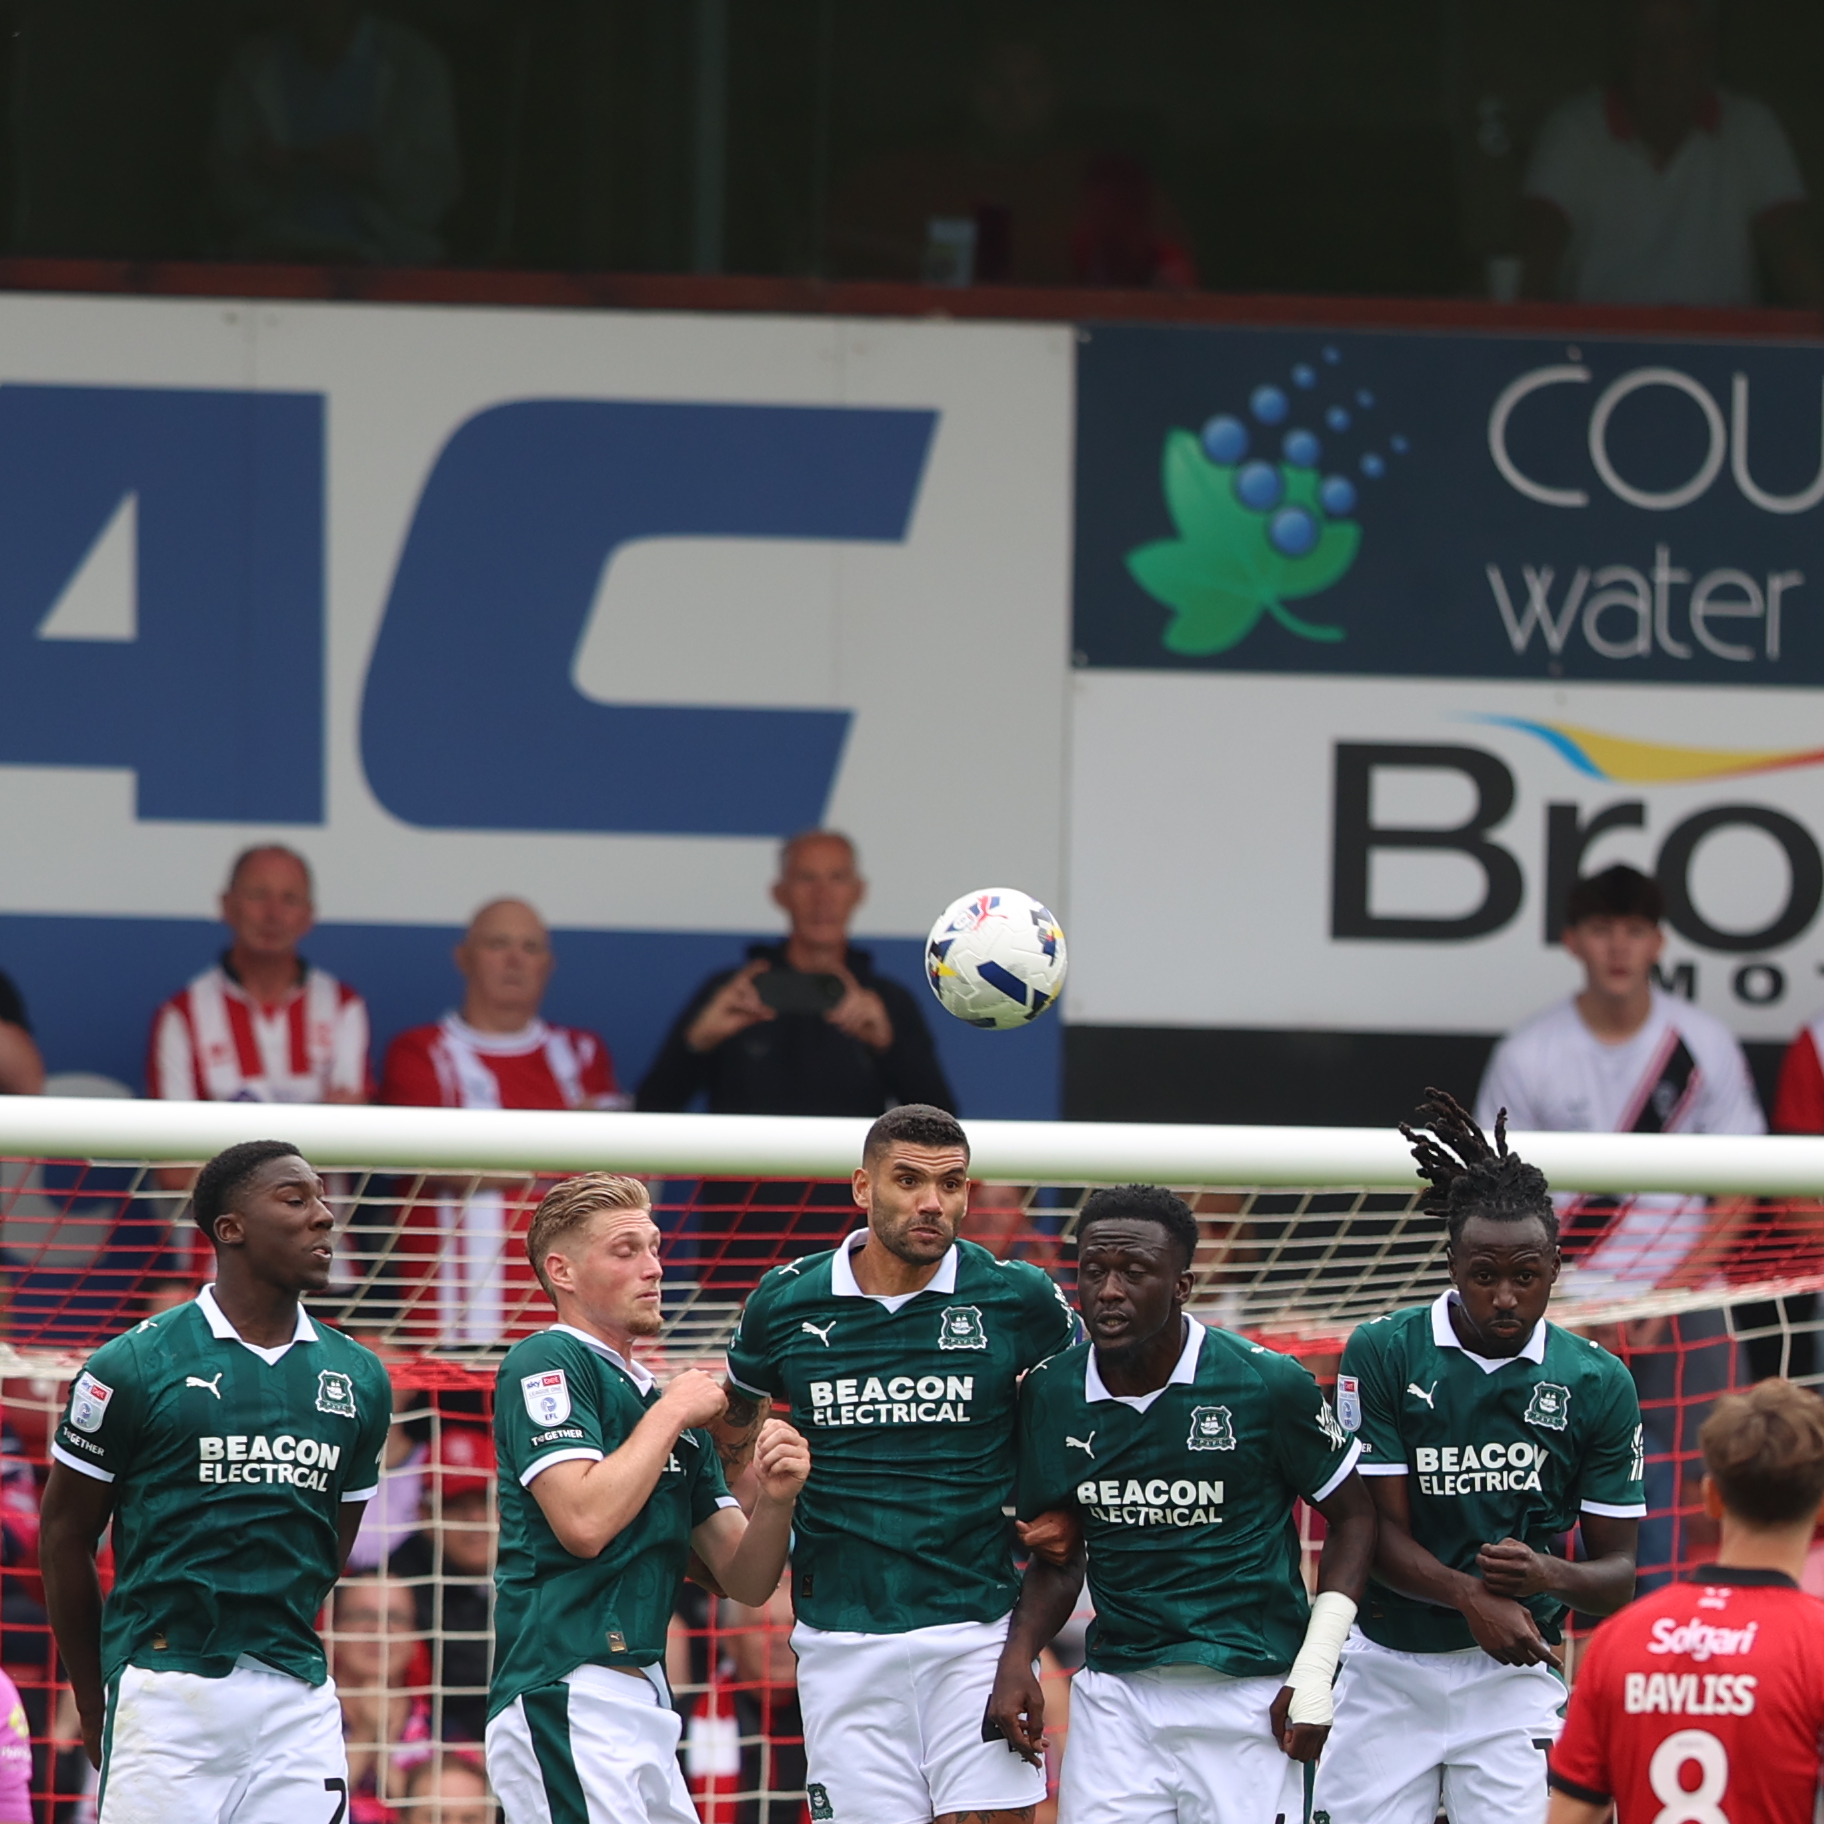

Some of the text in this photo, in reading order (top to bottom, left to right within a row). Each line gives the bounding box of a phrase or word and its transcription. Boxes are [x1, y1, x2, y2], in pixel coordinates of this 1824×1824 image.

[1486, 545, 1805, 663] water
[810, 1376, 973, 1407] BEACON
[812, 1403, 971, 1427] ELECTRICAL
[199, 1435, 341, 1471] BEACON
[1077, 1479, 1224, 1506] BEACON
[1420, 1470, 1542, 1496] ELECTRICA
[1648, 1618, 1757, 1661] Solgari
[1625, 1672, 1757, 1716] BAYLISS
